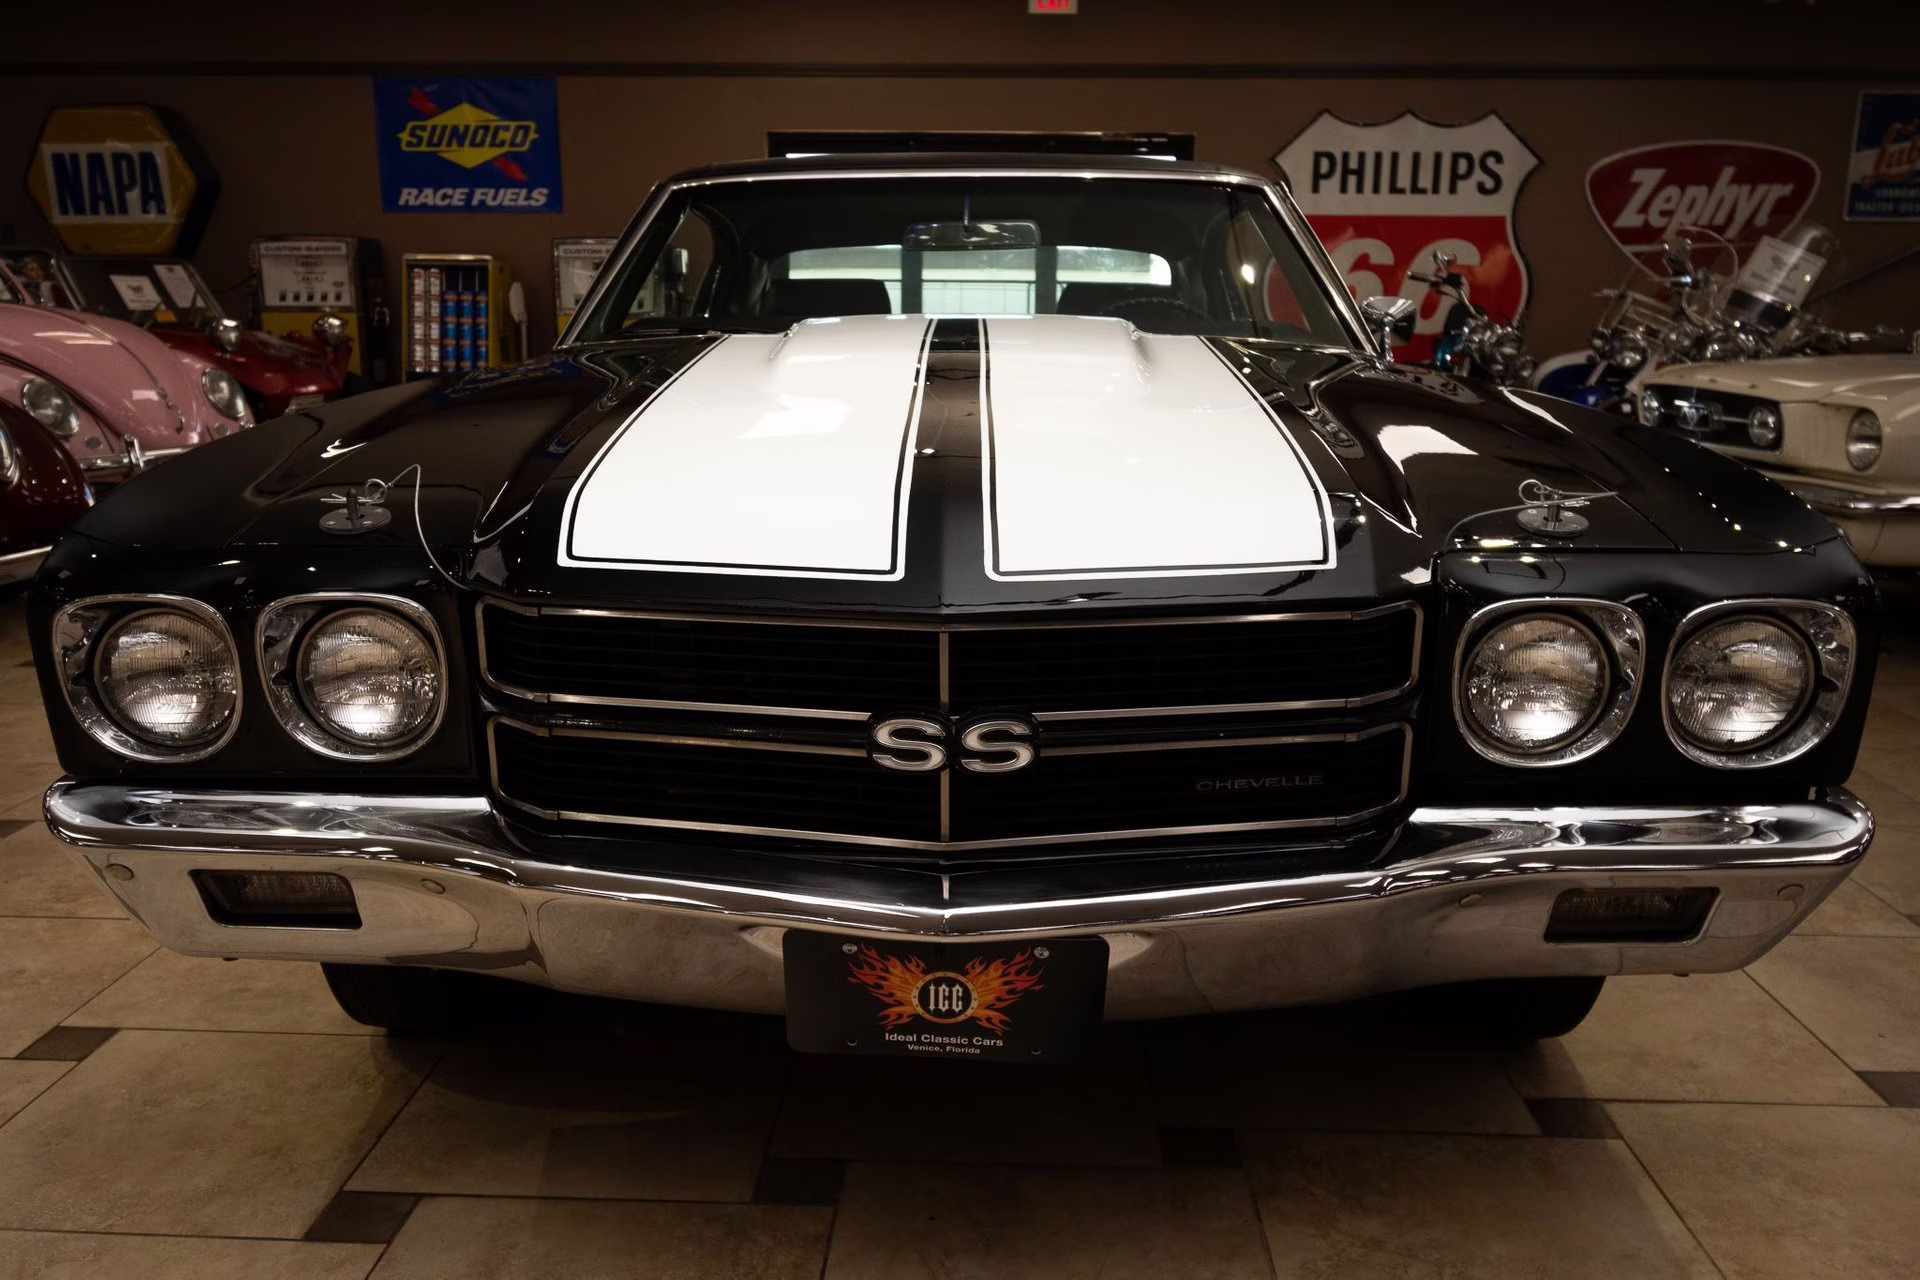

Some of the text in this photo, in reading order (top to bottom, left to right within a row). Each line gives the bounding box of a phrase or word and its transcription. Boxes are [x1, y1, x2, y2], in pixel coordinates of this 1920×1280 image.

[405, 124, 532, 149] SUNOCO
[51, 152, 167, 216] NAPA
[1311, 150, 1504, 196] PHILLIPS
[398, 187, 549, 206] RACE FUELS
[1613, 166, 1795, 240] Zephyr
[1328, 237, 1481, 346] 66
[872, 718, 1035, 773] SS
[1195, 774, 1325, 792] CHEVELLE
[928, 982, 963, 1013] ICC
[885, 1032, 1004, 1047] Ideal Classic Cars
[907, 1044, 980, 1054] Venice, Florida
